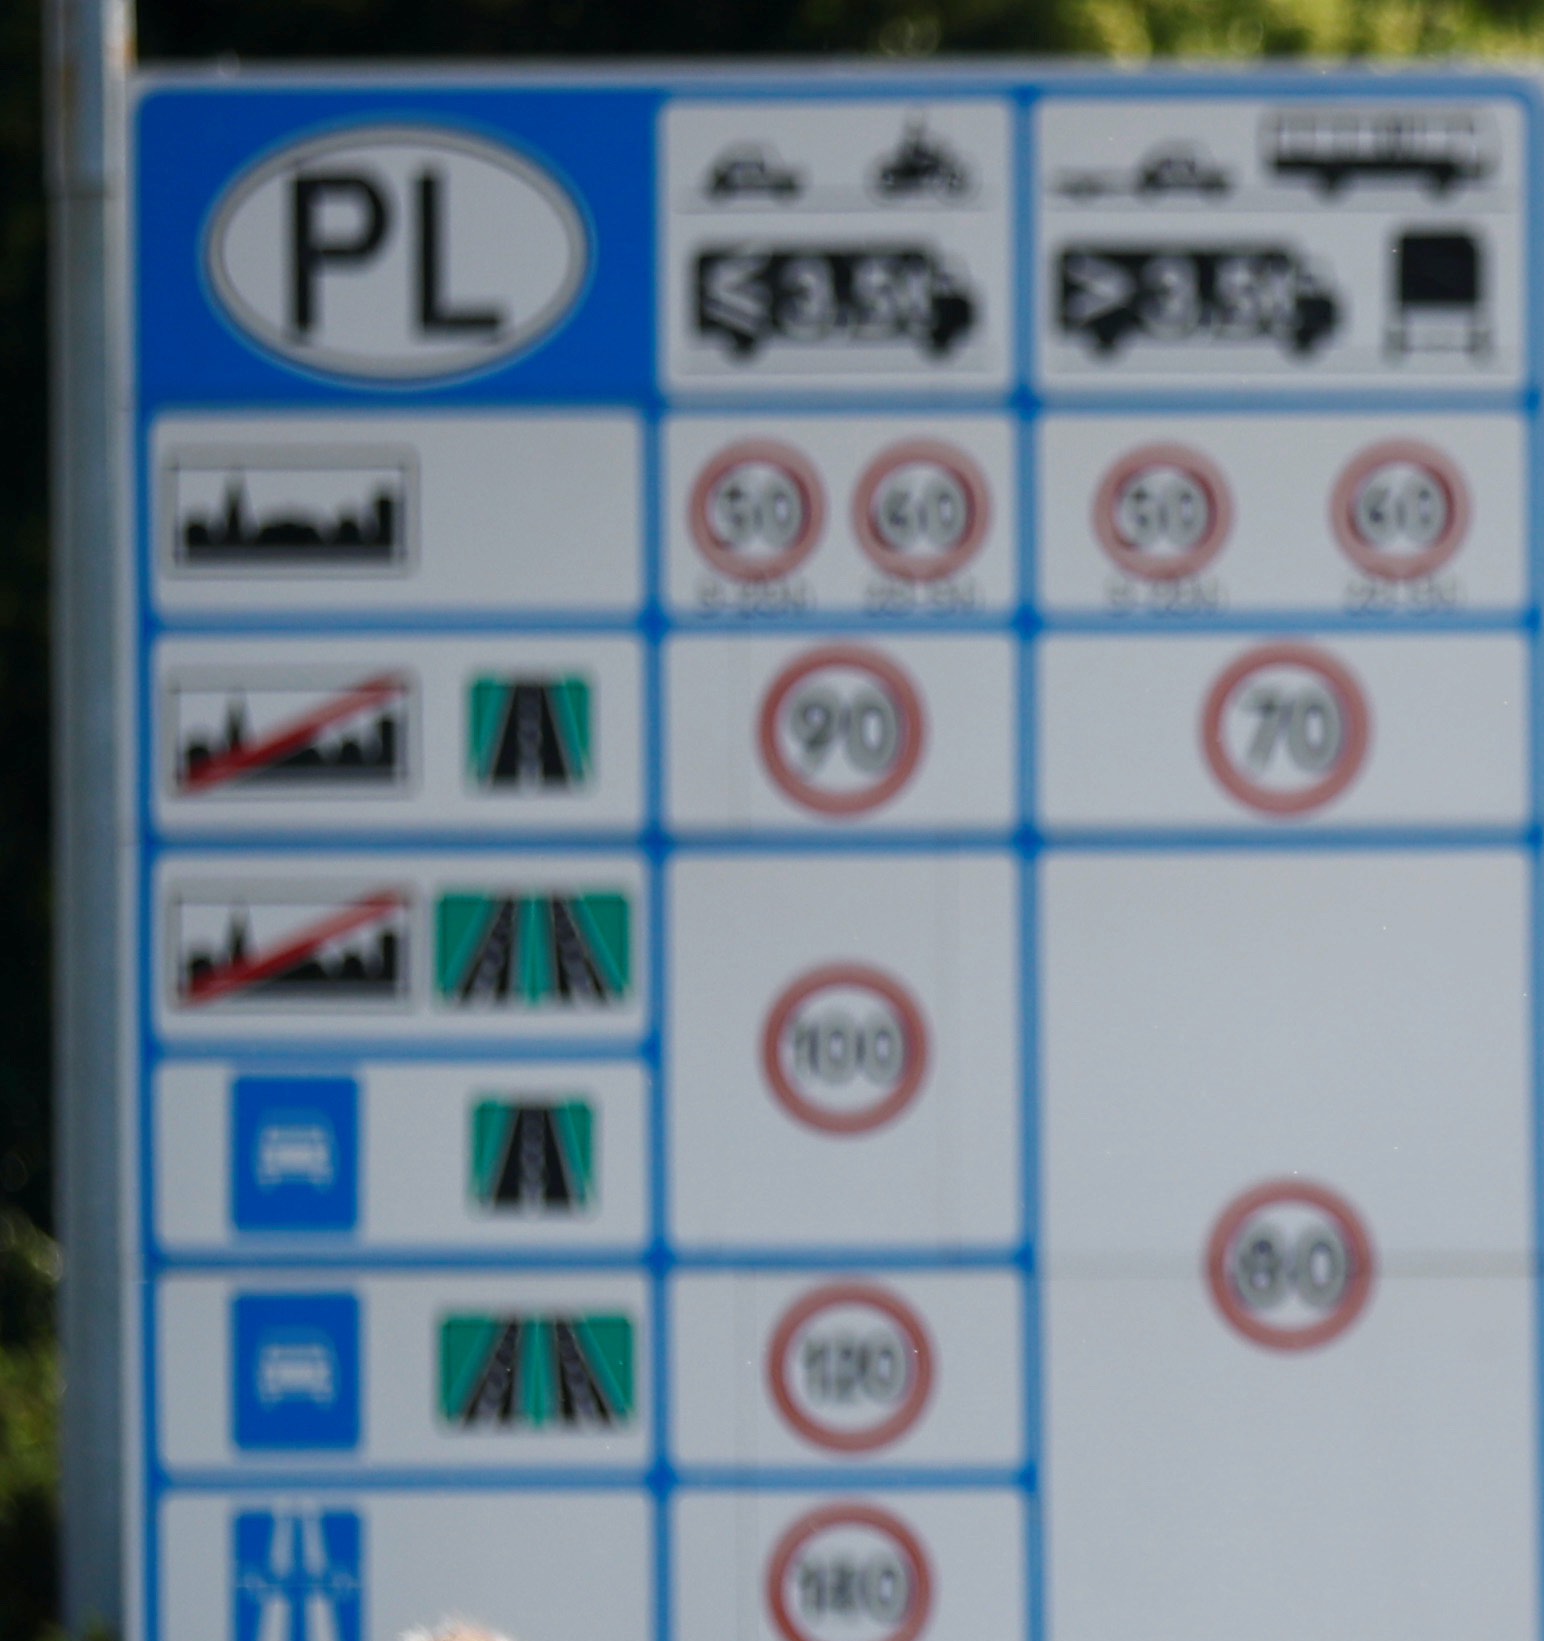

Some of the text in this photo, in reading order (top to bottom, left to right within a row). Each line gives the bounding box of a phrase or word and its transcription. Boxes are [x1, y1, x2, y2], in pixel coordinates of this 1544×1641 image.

[284, 168, 507, 341] PL
[790, 688, 902, 776] 90
[1240, 686, 1346, 776] 70
[792, 1006, 908, 1088] 100
[1233, 1223, 1347, 1309] 80
